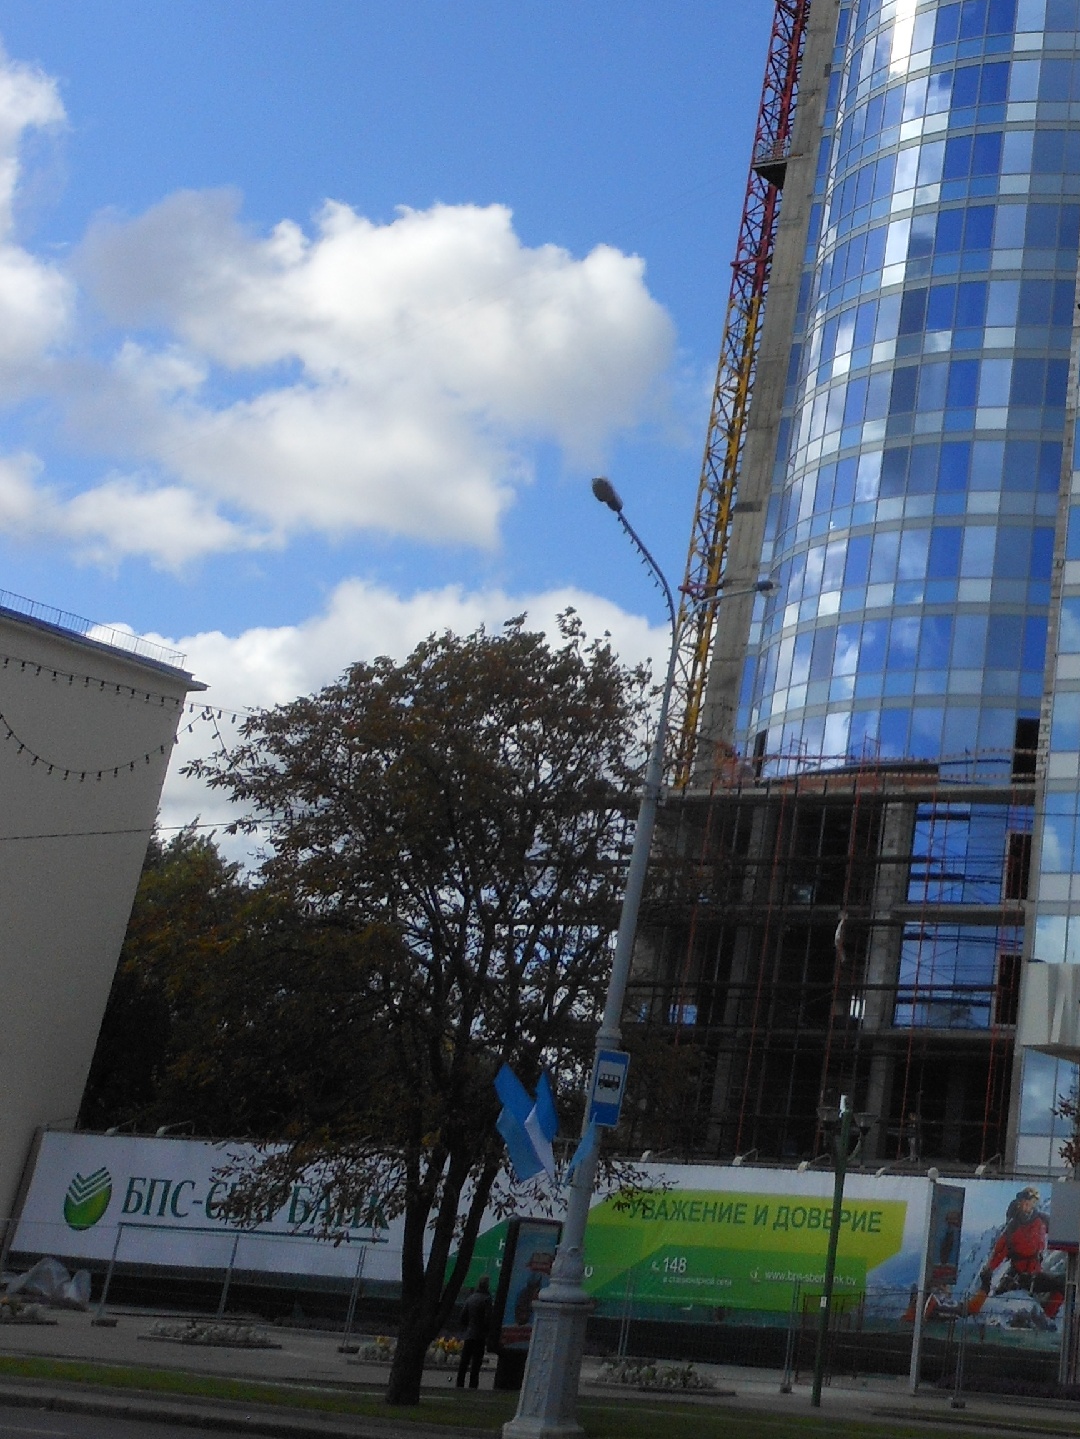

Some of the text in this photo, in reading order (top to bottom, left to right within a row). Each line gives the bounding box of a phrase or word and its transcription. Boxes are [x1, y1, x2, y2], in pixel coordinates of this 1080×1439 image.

[121, 1175, 391, 1231] БПС-СБАНК
[629, 1197, 884, 1234] УВАЖЕНИЕ И ДОВЕРИЕ
[662, 1256, 688, 1274] 148
